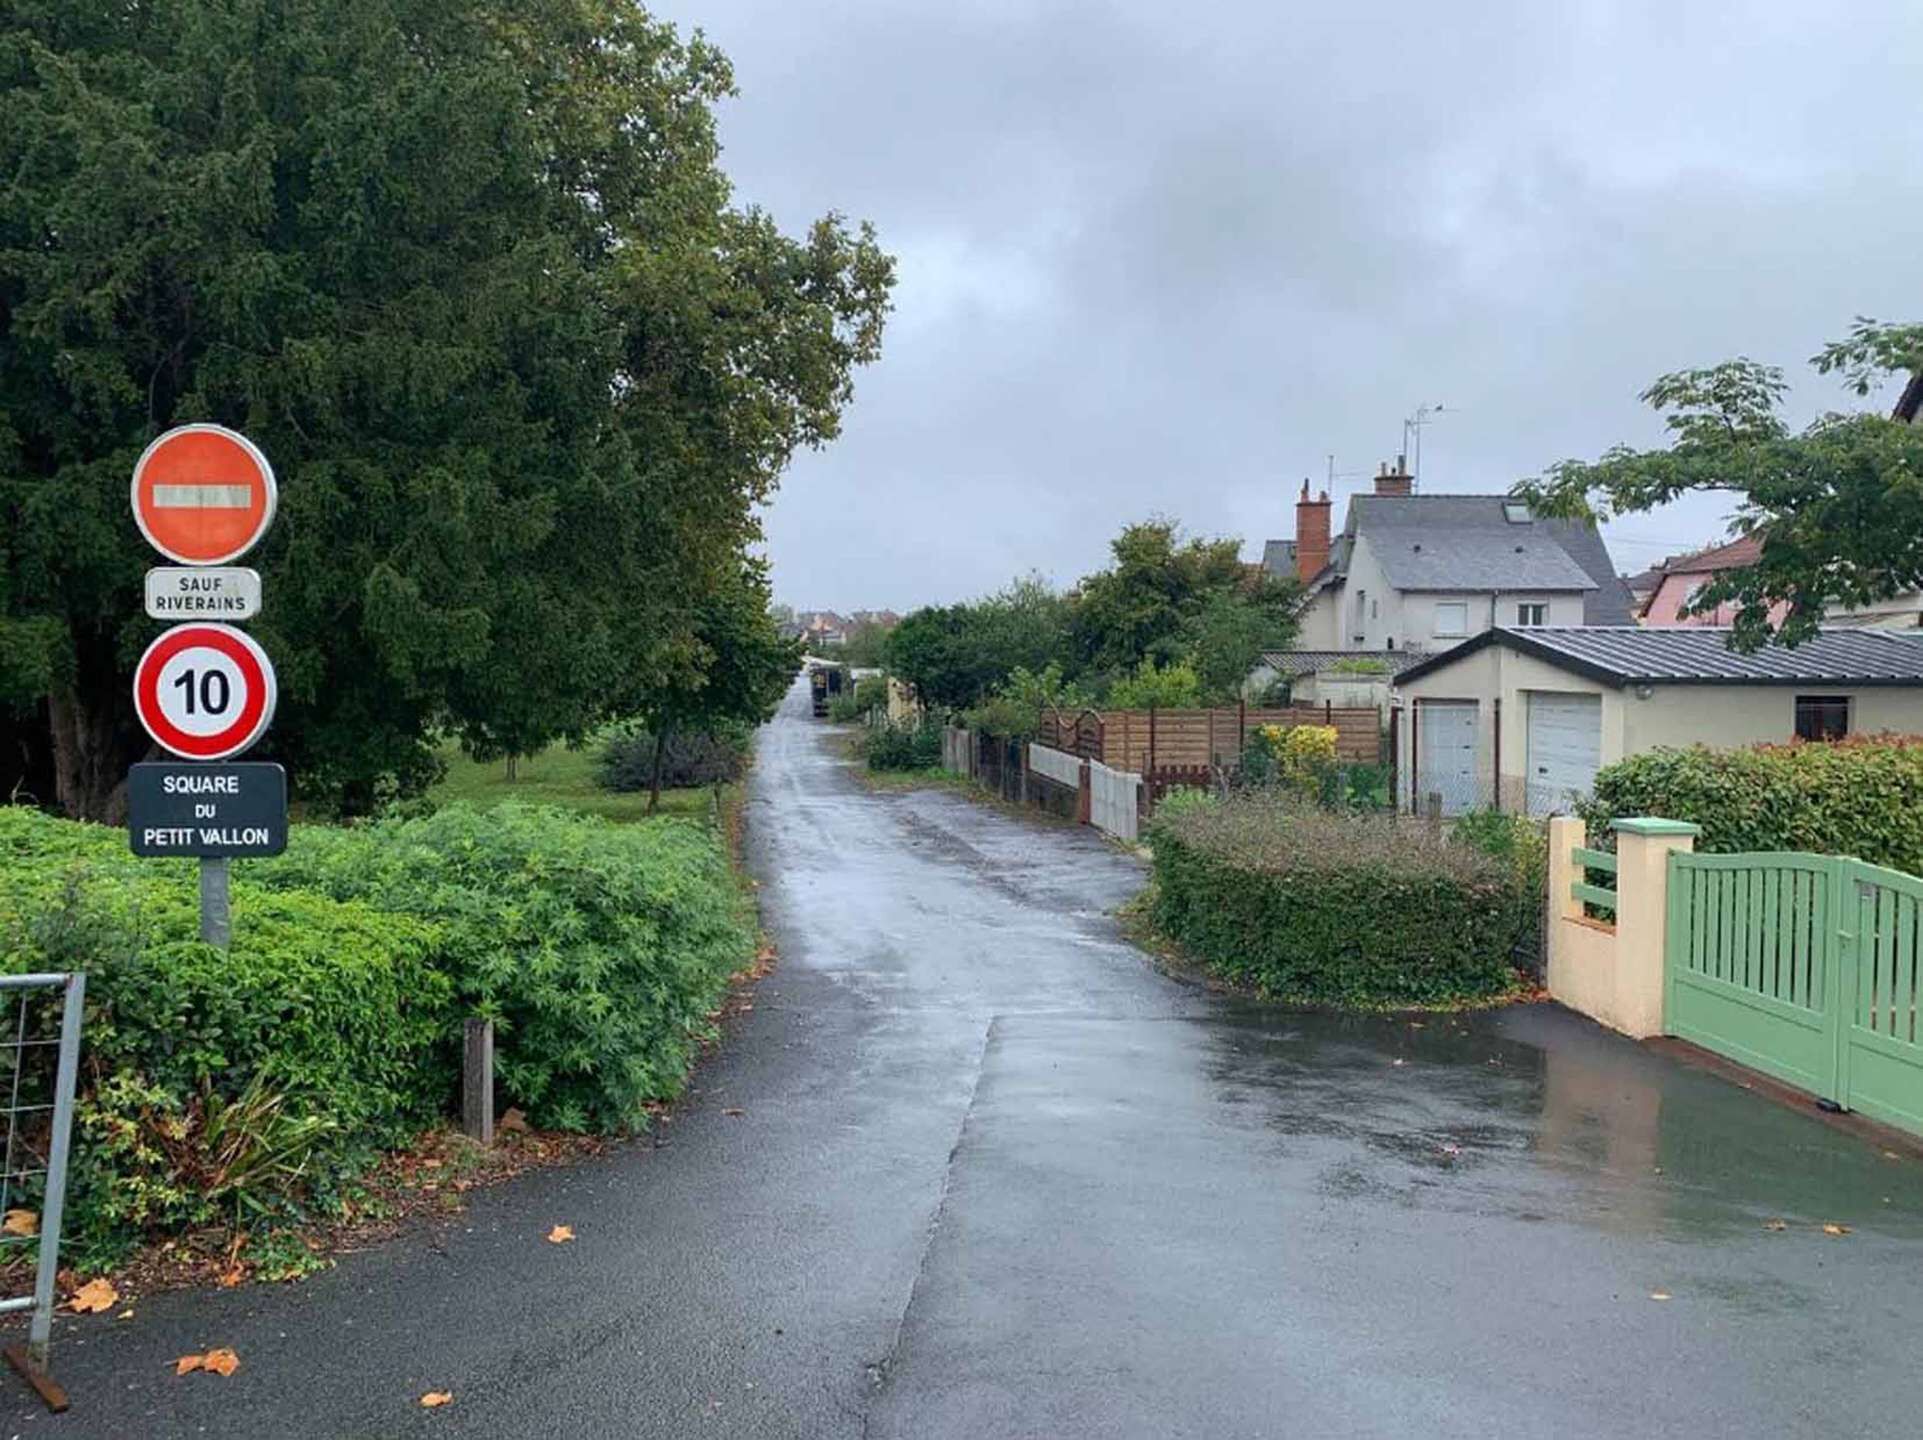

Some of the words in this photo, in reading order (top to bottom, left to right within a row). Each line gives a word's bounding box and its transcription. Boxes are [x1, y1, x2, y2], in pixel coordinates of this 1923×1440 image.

[179, 577, 223, 591] SAUF
[156, 597, 246, 611] RIVERAINS
[174, 669, 231, 715] 10
[163, 775, 240, 794] SQUARE
[195, 804, 216, 818] DU
[144, 829, 194, 846] PETIT
[199, 828, 270, 846] VALLON
